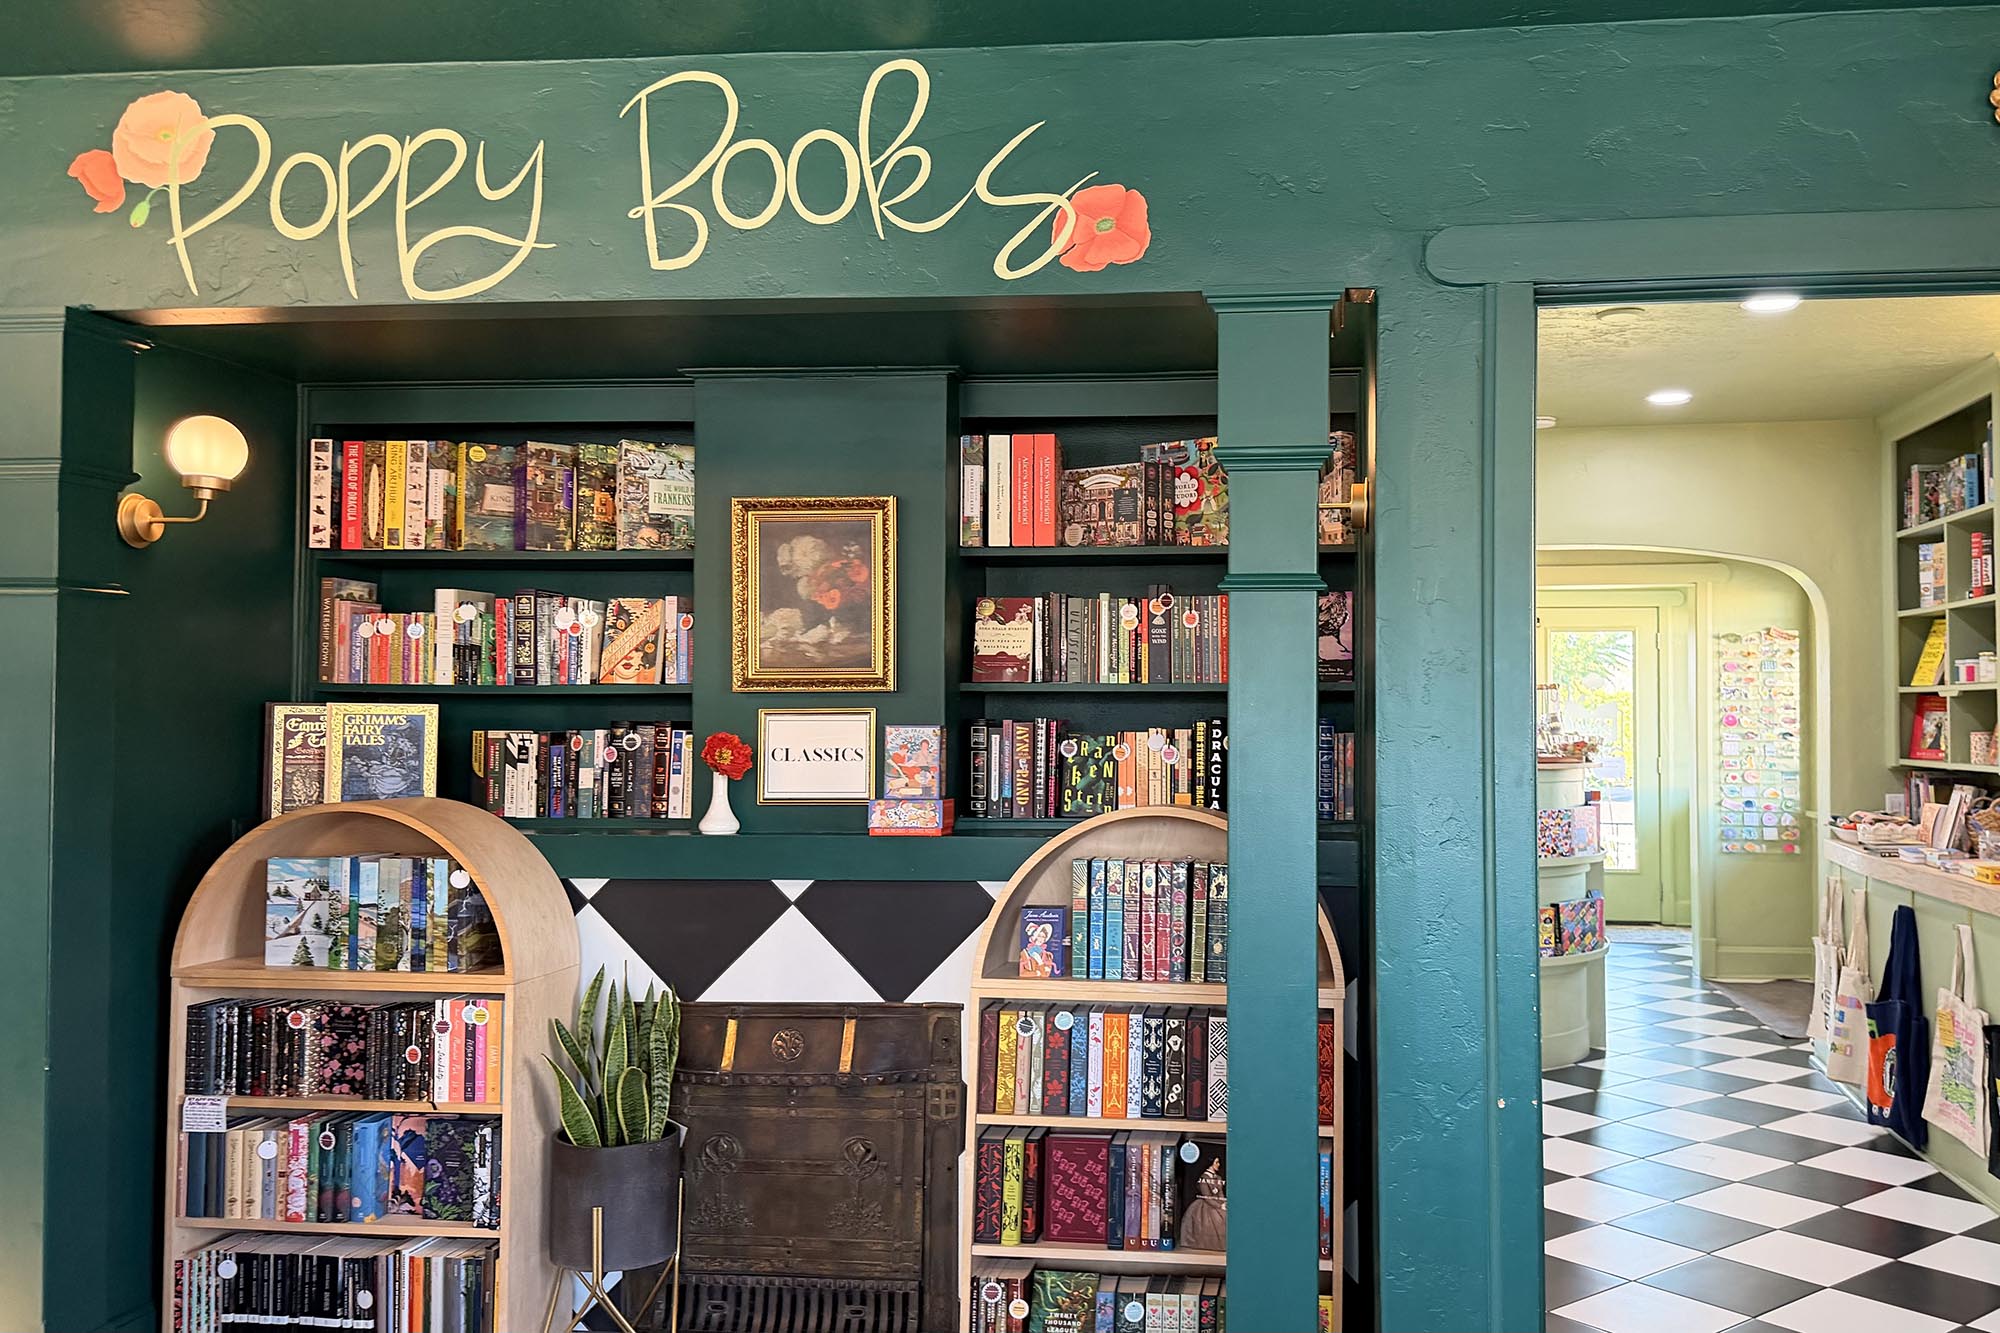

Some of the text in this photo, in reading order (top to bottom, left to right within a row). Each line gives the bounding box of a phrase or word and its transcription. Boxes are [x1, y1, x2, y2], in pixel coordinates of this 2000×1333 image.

[167, 58, 1099, 303] Poppy Books
[346, 444, 359, 521] THE WORLD OF DRACULA
[389, 444, 399, 505] KING ARTHUR
[654, 492, 695, 506] FRANKENST
[321, 597, 332, 667] WATERSHIP DOWN
[1069, 610, 1080, 662] ULYSSES
[342, 735, 386, 746] TALES
[343, 725, 385, 736] FAIRY
[344, 714, 407, 726] GRIMM'S
[771, 747, 864, 762] CLASSICS
[1015, 726, 1030, 805] AYN RAND
[1210, 728, 1222, 810] DRACULA
[1024, 910, 1059, 920] Jane Austen
